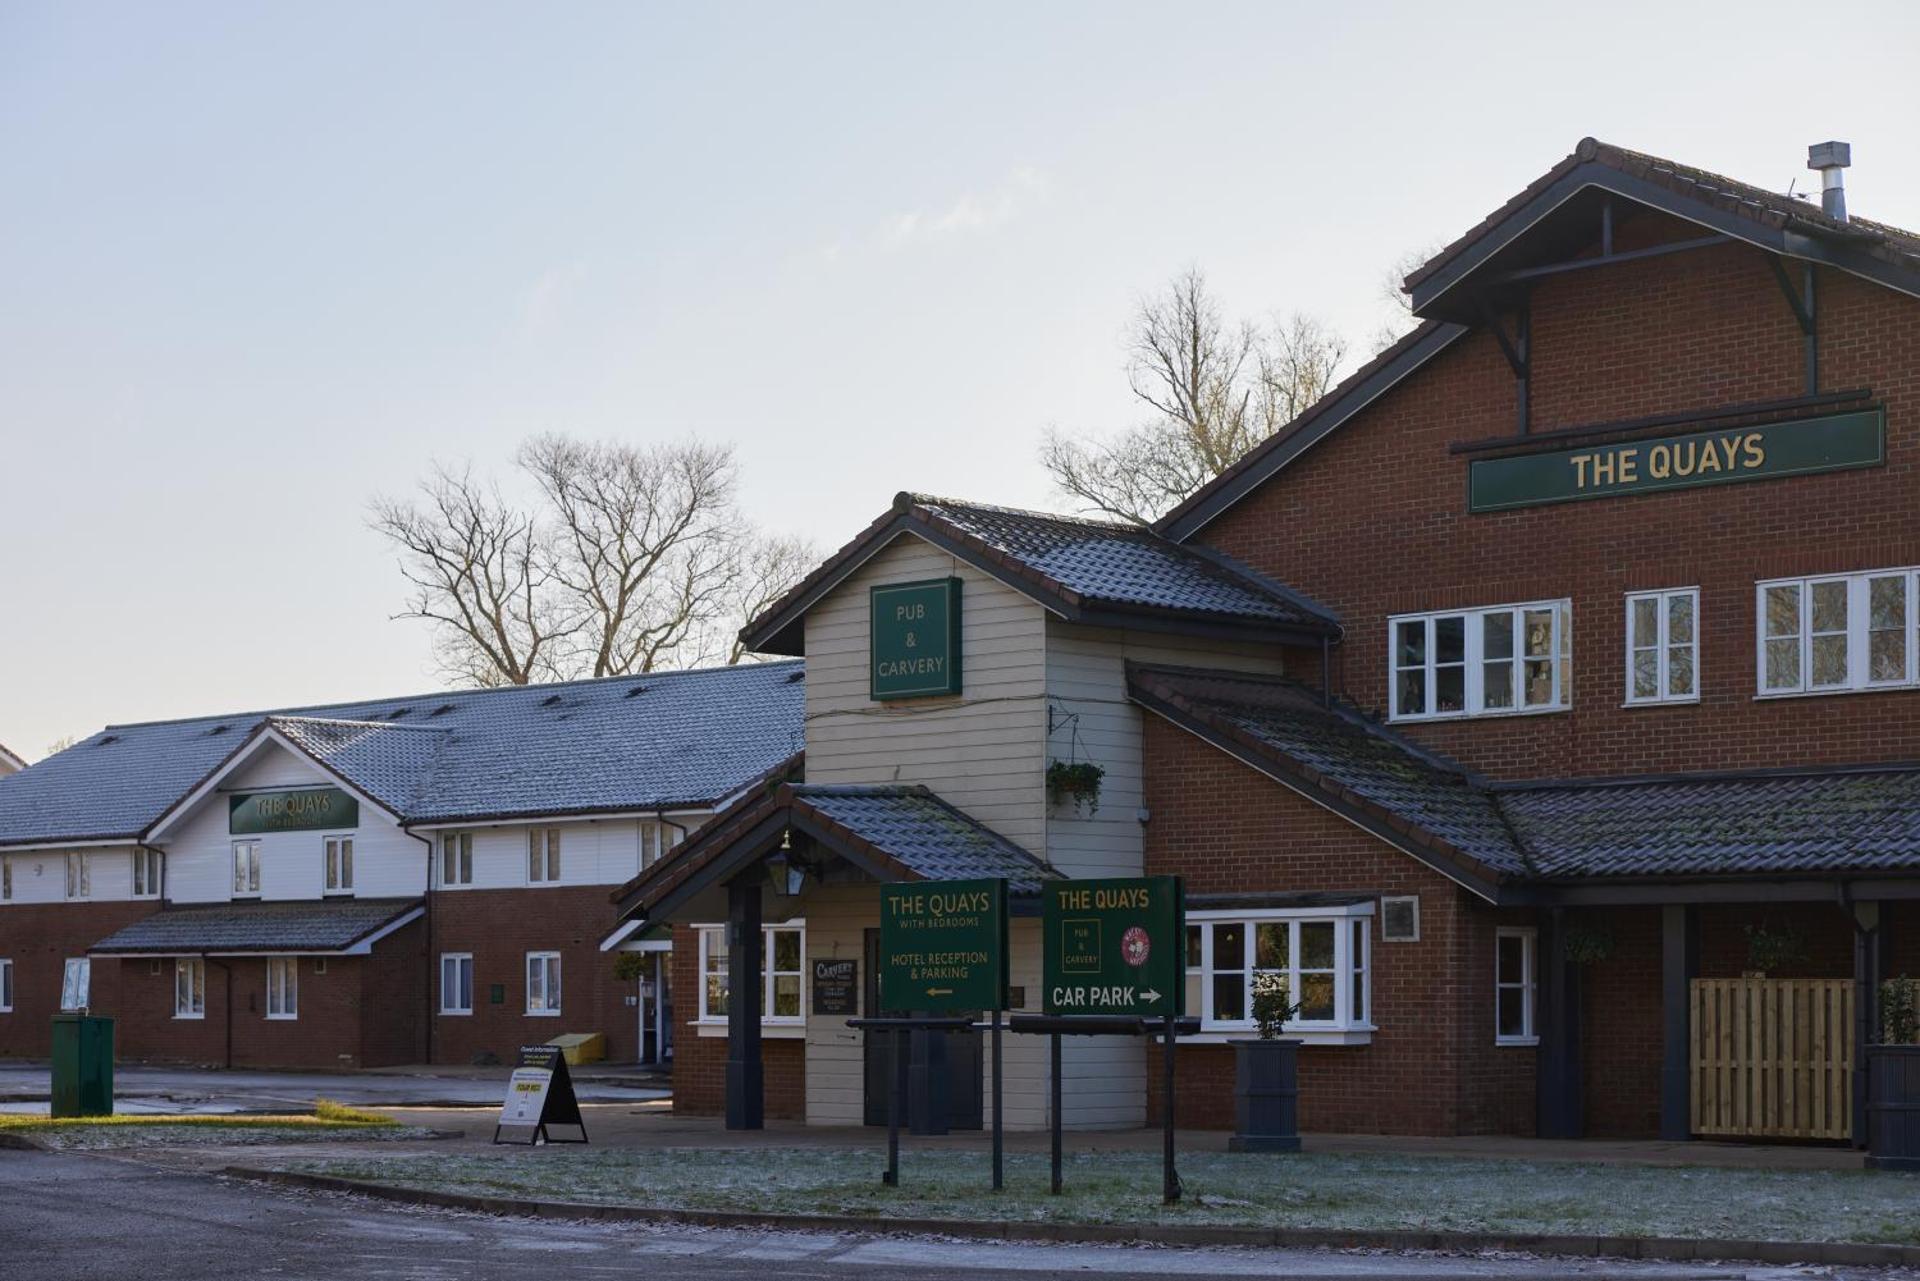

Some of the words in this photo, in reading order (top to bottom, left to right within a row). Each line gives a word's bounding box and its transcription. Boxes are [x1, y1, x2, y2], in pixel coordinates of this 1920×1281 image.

[1570, 449, 1638, 489] THE
[1649, 433, 1765, 480] QUAYS
[897, 603, 925, 621] PUB
[906, 631, 917, 648] &
[878, 656, 944, 677] CARVERY
[256, 798, 283, 816] THE
[287, 795, 330, 816] QUAYS
[888, 895, 924, 917] THE
[929, 892, 990, 917] QUAYS
[1058, 890, 1091, 909] THE
[1095, 888, 1150, 909] QUAYS
[899, 918, 925, 929] WITH
[928, 917, 979, 929] BEDROOMS
[1074, 927, 1089, 937] PUB
[891, 954, 925, 966] HOTEL
[928, 951, 988, 966] RECEPTION
[1065, 955, 1098, 965] CARVERY
[910, 968, 918, 980] &
[921, 966, 968, 980] PARKING
[1052, 987, 1085, 1006] CAR
[1089, 986, 1135, 1006] PARK
